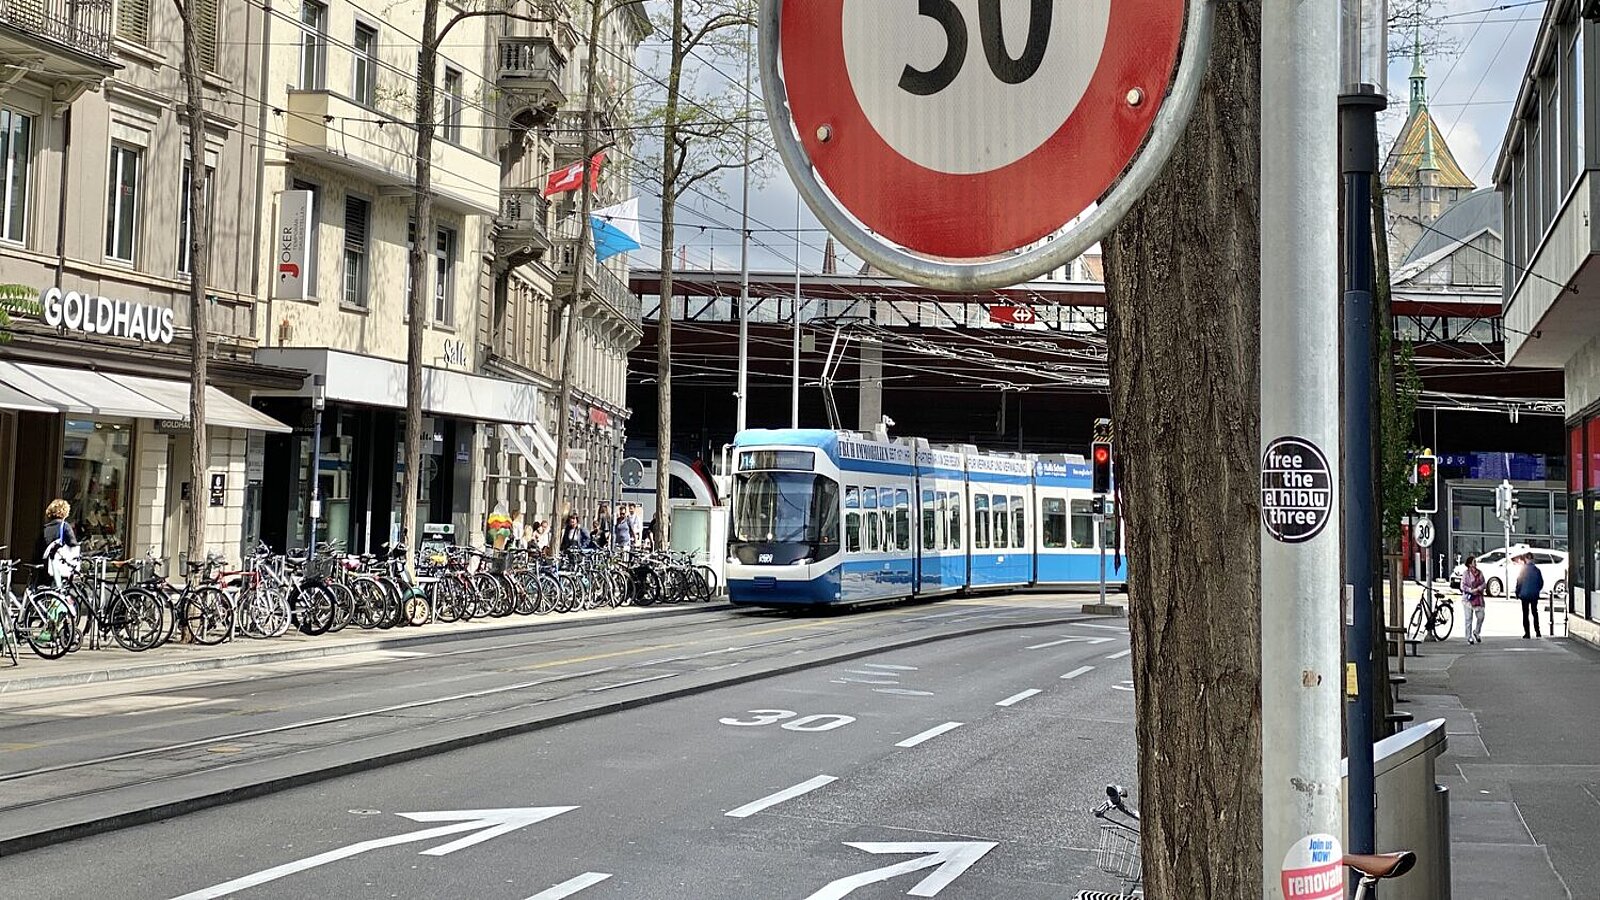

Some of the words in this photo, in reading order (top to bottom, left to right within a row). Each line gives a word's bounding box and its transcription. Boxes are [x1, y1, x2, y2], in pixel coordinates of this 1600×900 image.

[279, 226, 300, 279] JOKER
[44, 287, 174, 344] GOLDHAUS
[743, 455, 756, 470] 14
[1269, 450, 1303, 468] free
[1282, 471, 1314, 487] the
[1265, 490, 1277, 506] el
[1270, 508, 1317, 525] three
[1419, 524, 1430, 536] 30
[718, 709, 857, 731] 30
[1309, 839, 1324, 850] Join
[1325, 840, 1333, 850] us
[1312, 850, 1331, 863] NOW!
